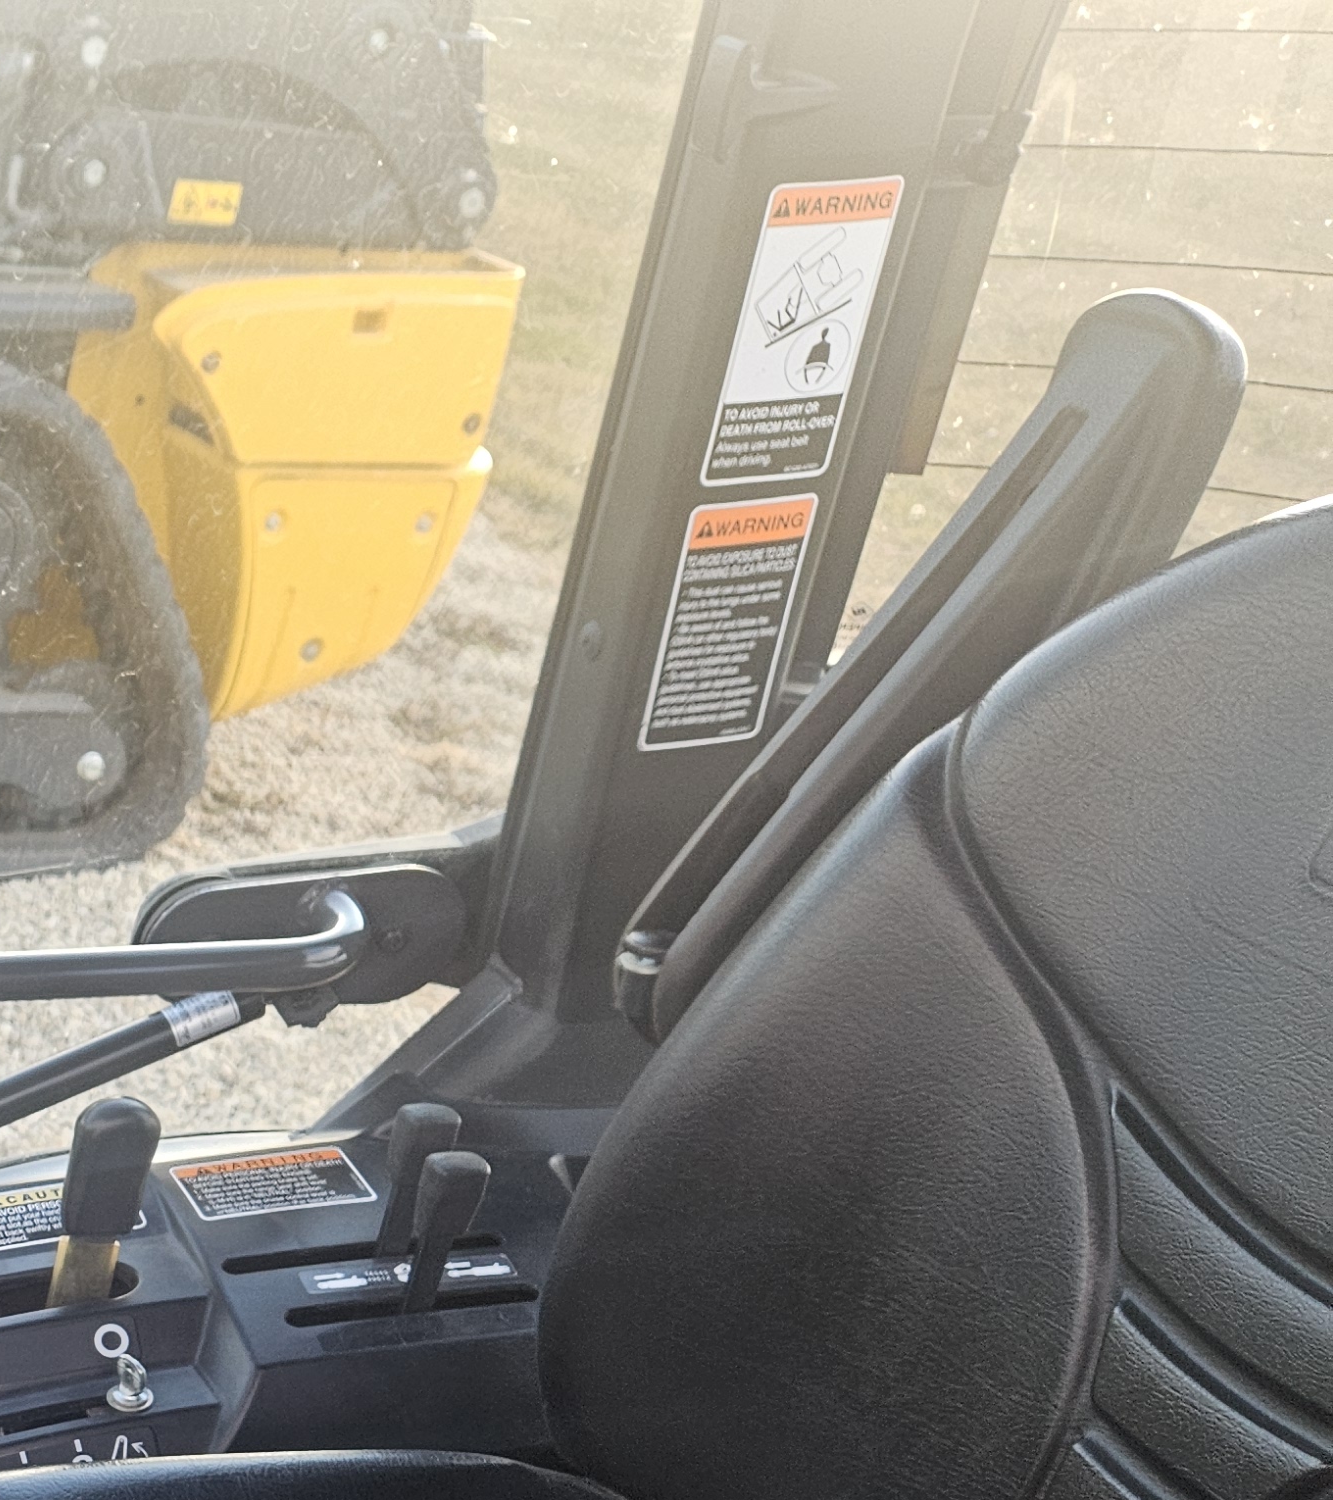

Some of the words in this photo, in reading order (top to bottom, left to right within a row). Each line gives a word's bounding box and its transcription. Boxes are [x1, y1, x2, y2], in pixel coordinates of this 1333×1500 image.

[794, 189, 894, 217] WARNING
[724, 408, 738, 421] TO
[739, 405, 769, 420] AVOID
[770, 403, 803, 418] INJURY
[804, 401, 820, 414] OR
[719, 423, 753, 437] DEATH
[753, 421, 782, 435] FROM
[716, 512, 804, 537] WARNING
[217, 1152, 323, 1173] WARNING
[7, 1189, 60, 1204] CAUT
[27, 1200, 62, 1213] PERSO
